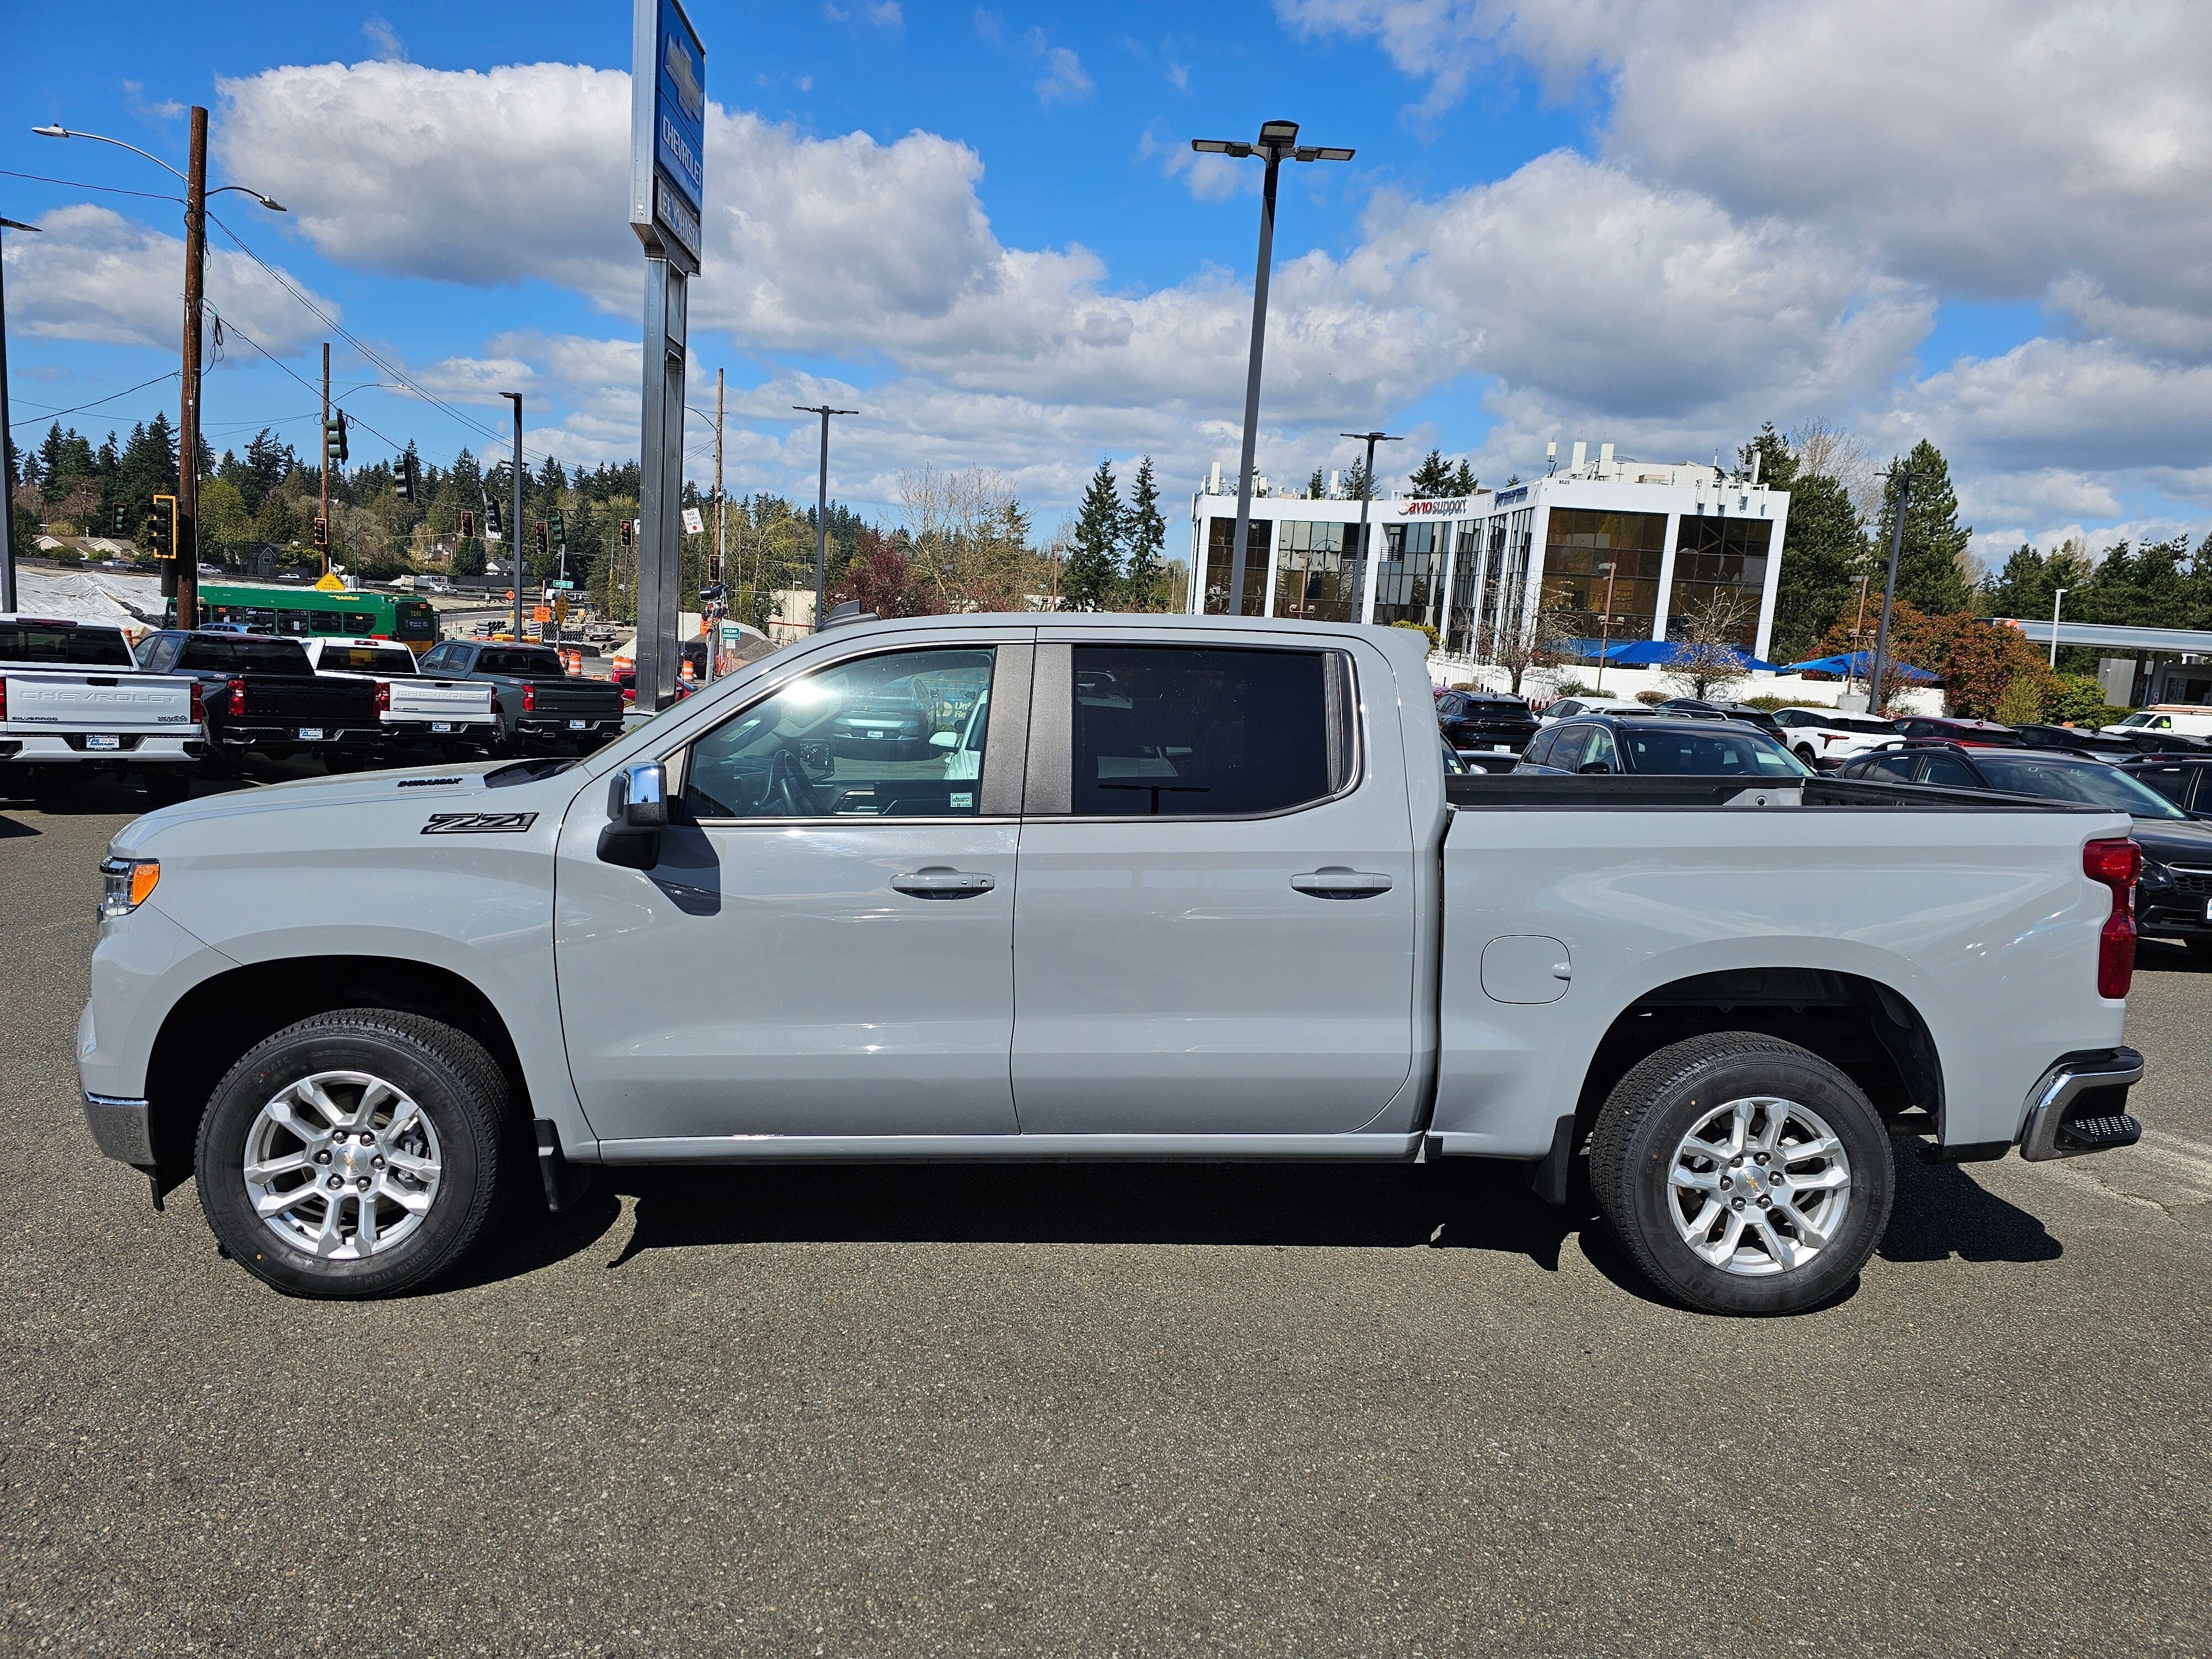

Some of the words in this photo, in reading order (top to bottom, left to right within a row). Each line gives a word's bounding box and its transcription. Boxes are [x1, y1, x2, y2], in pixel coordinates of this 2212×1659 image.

[662, 114, 702, 189] CHEVROLET
[658, 186, 671, 222] LEE
[672, 208, 700, 255] JOHNSON
[20, 691, 179, 703] CHEVROLET
[397, 691, 487, 700] CHEVROLET
[955, 702, 972, 710] Uni
[397, 778, 463, 787] DURAMAX
[420, 812, 540, 834] Z71
[1654, 1123, 1673, 1148] SAFE
[364, 1272, 394, 1285] 110H
